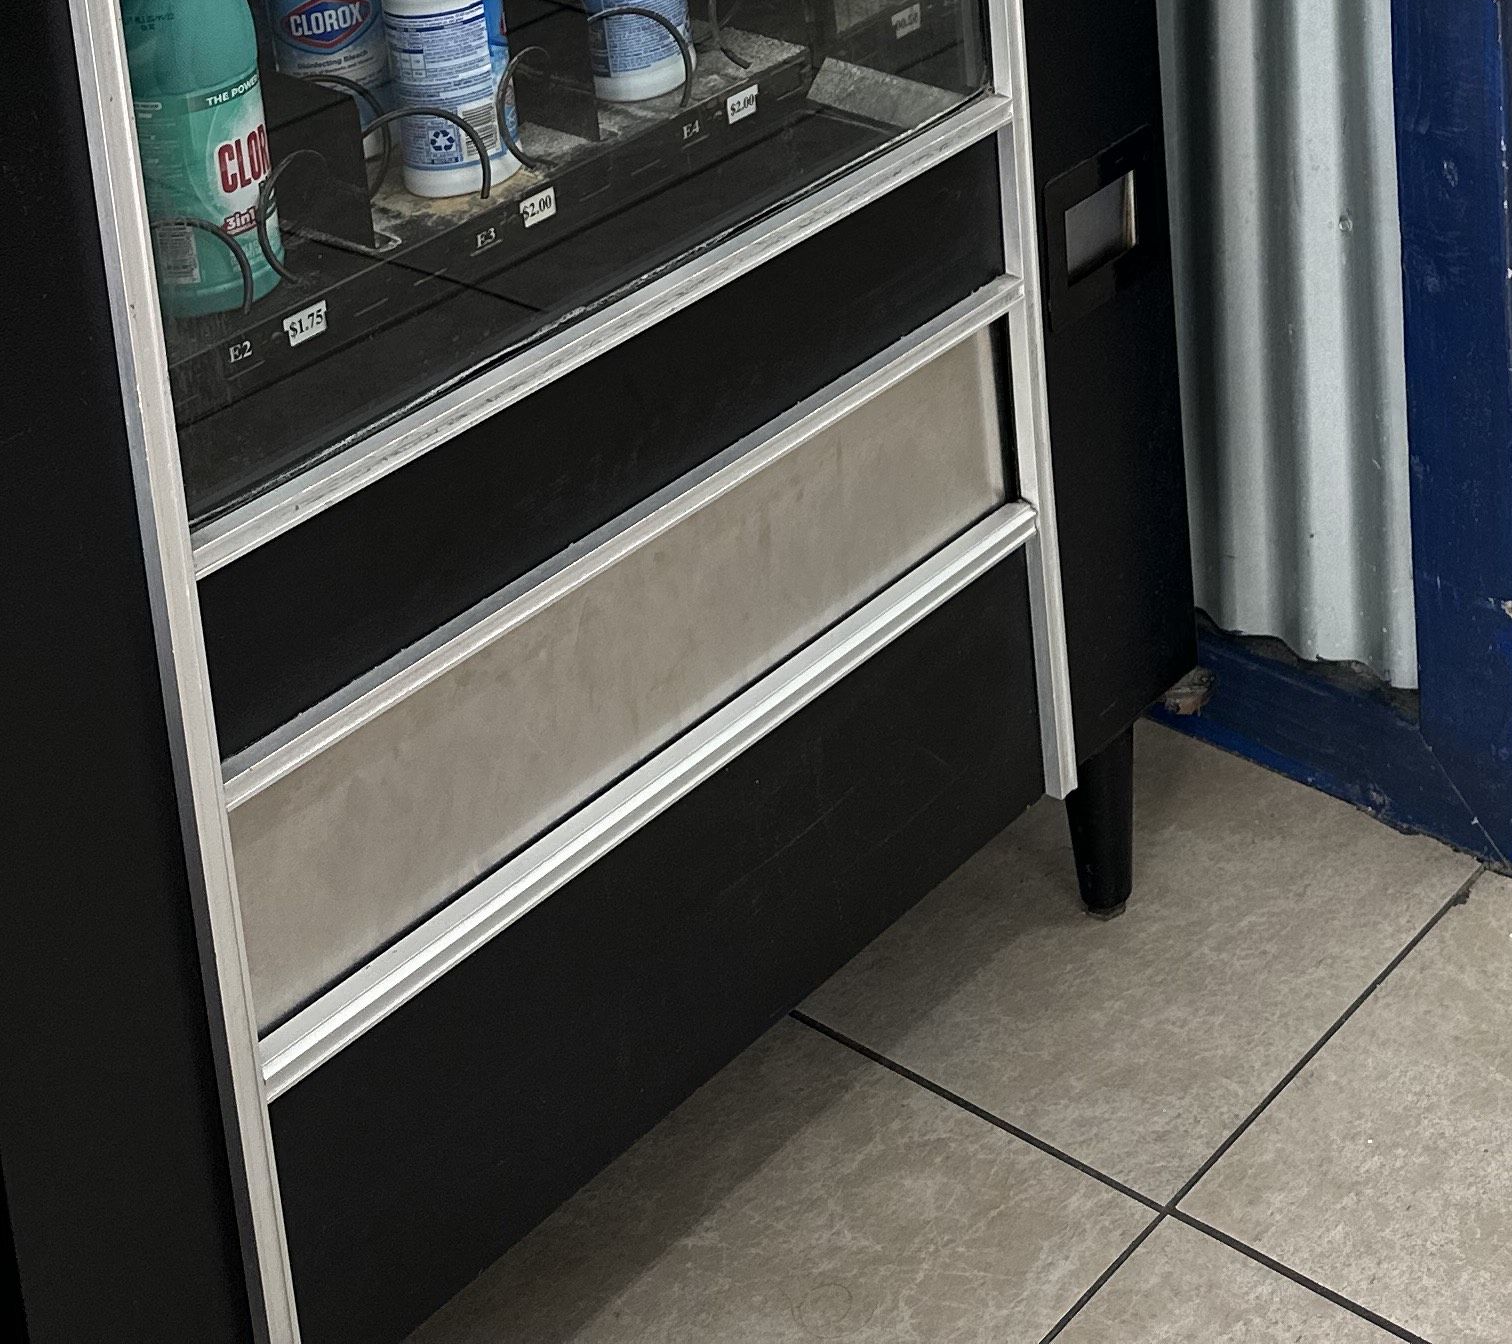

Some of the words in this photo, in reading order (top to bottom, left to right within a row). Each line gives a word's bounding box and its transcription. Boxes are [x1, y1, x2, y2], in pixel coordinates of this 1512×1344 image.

[289, 0, 364, 38] CLOROX
[206, 91, 230, 108] THE
[682, 119, 701, 140] E4
[729, 92, 756, 116] $2.00
[476, 227, 497, 248] E3
[522, 194, 554, 220] $2.00
[228, 339, 254, 364] E2
[288, 309, 324, 338] $1.75
